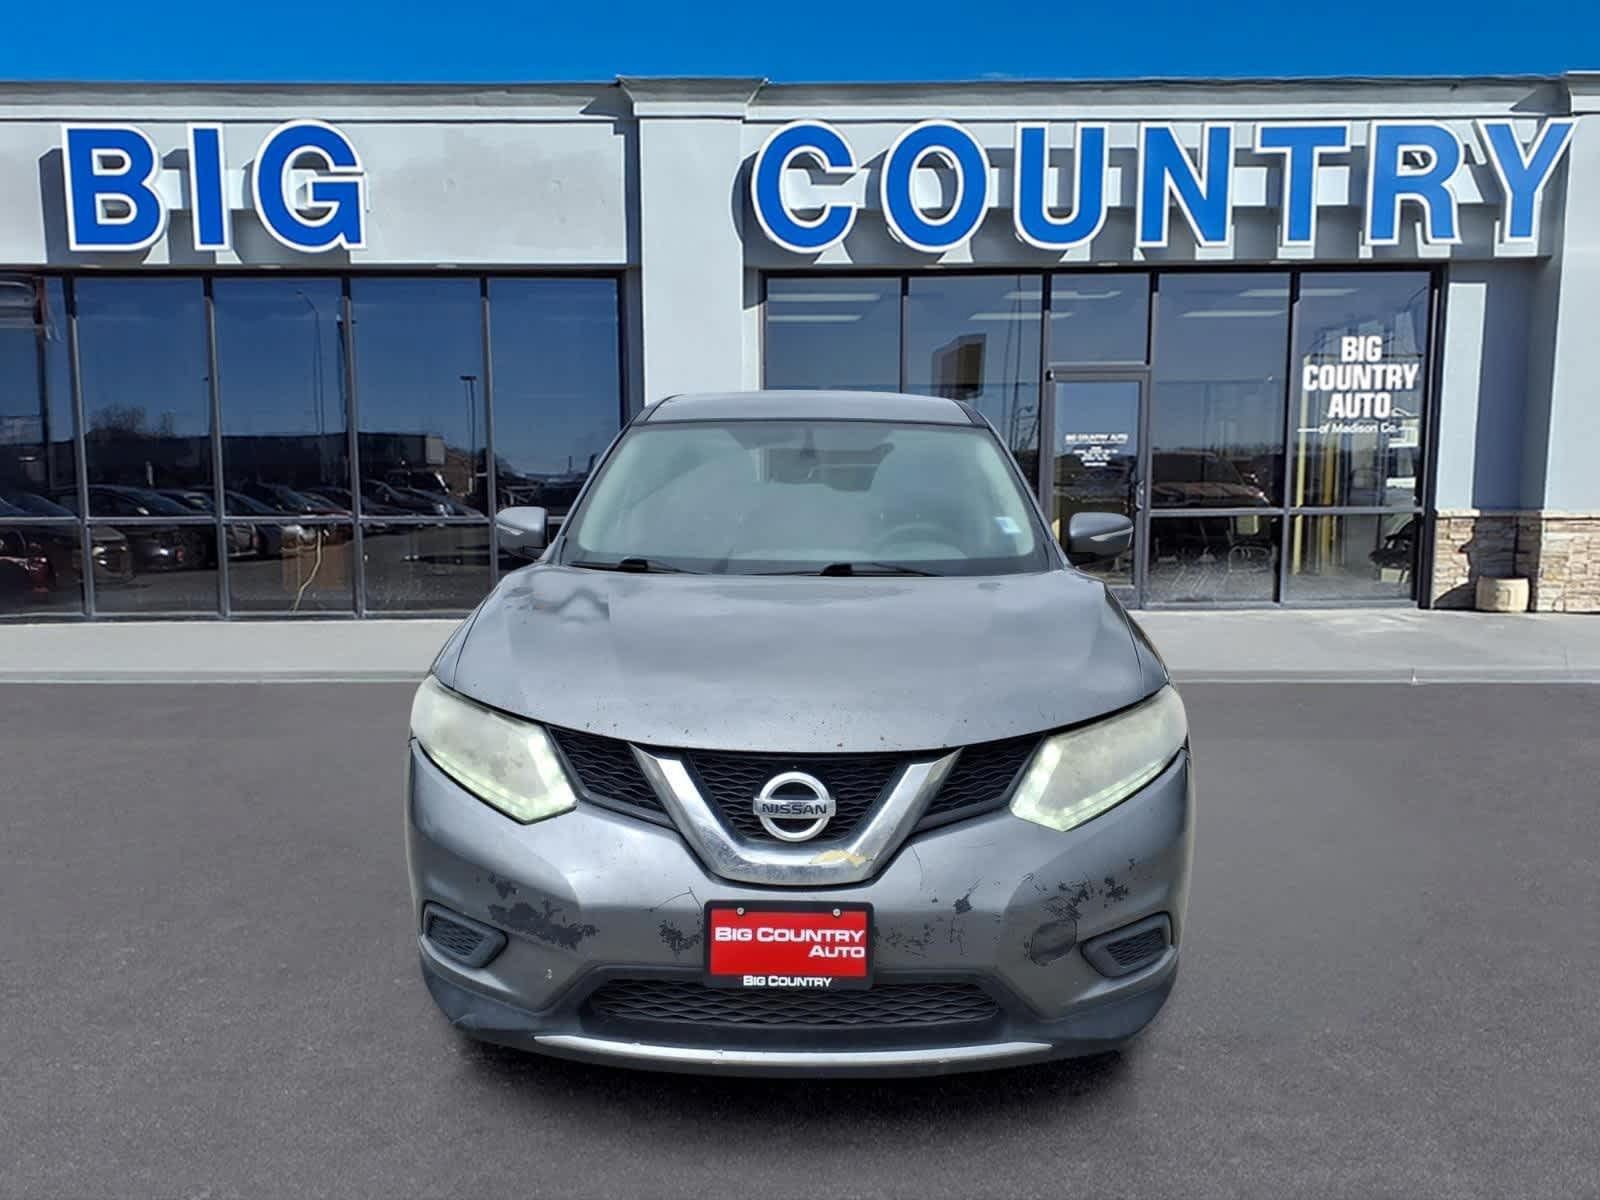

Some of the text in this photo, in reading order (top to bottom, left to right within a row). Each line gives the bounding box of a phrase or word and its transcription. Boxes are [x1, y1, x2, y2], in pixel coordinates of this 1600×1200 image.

[61, 118, 1577, 254] BIG COUNTRY
[1341, 336, 1382, 362] BIG
[1302, 364, 1419, 390] COUNTRY
[1328, 392, 1391, 418] AUTO
[762, 803, 827, 815] NISSAN
